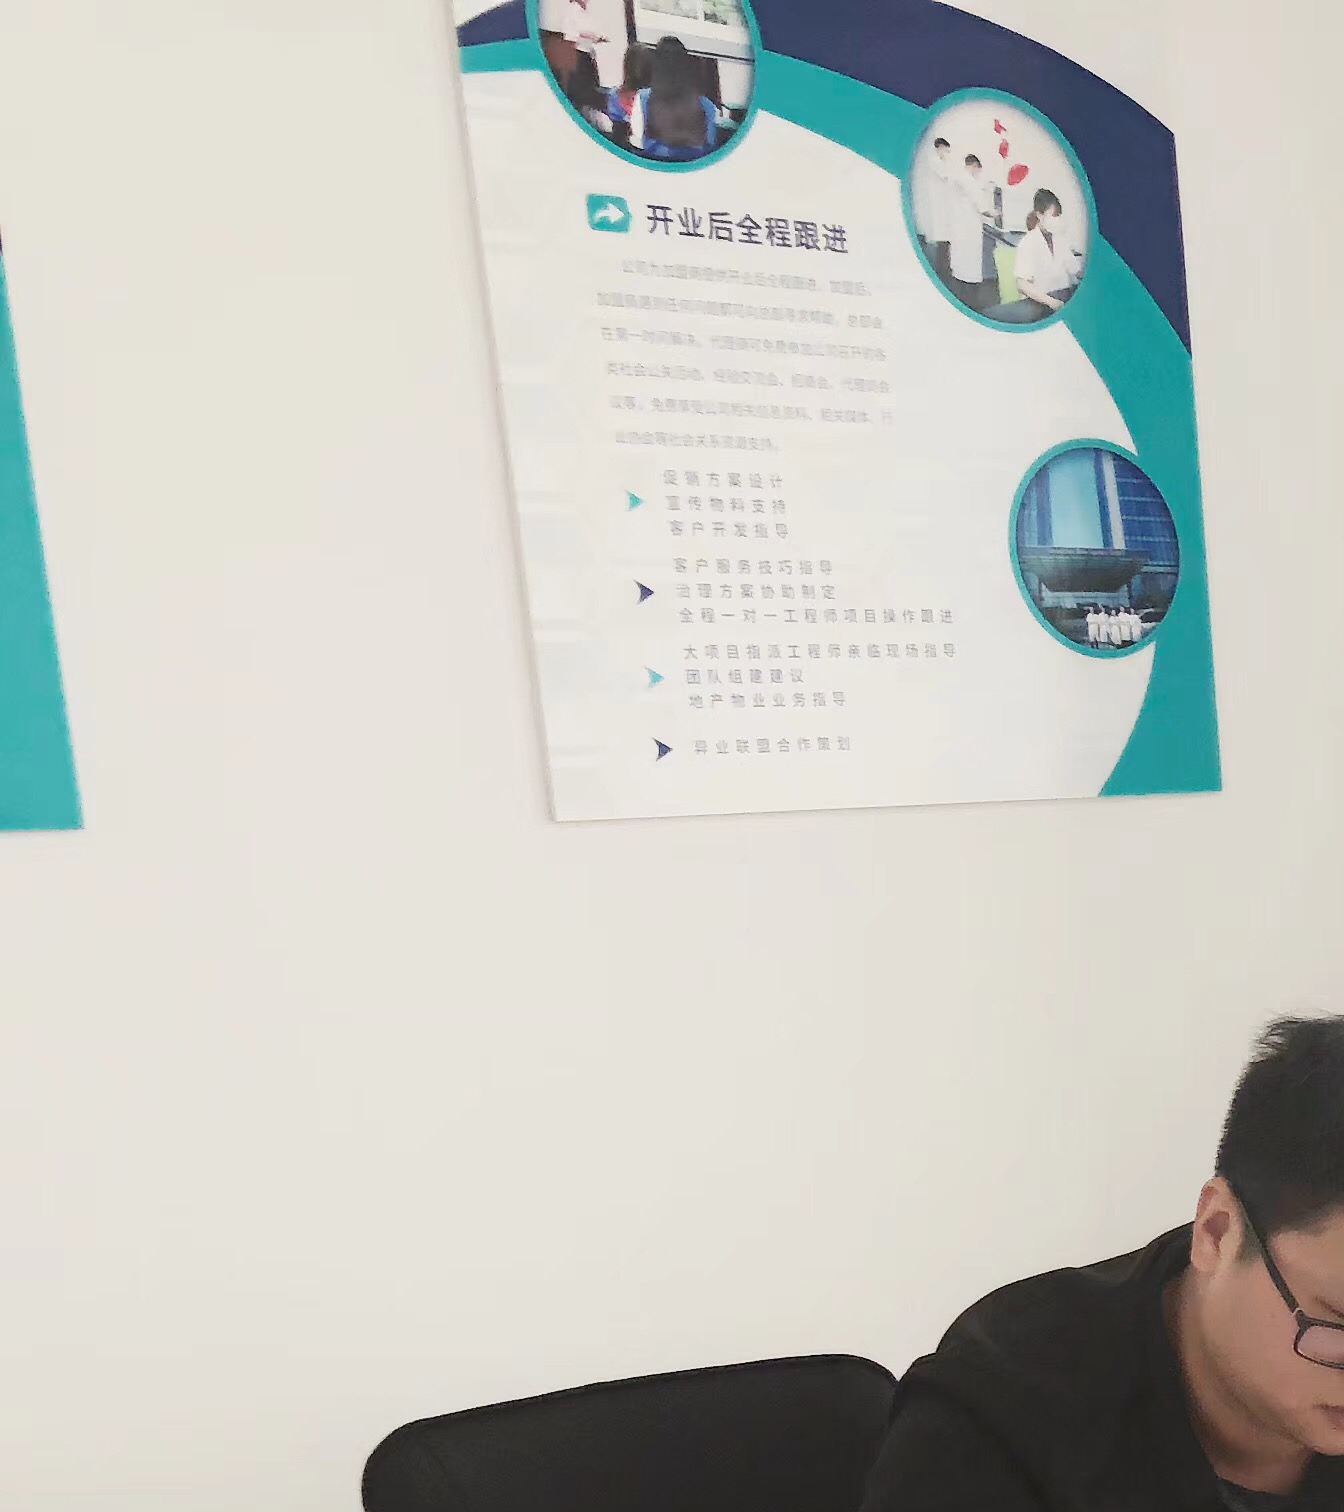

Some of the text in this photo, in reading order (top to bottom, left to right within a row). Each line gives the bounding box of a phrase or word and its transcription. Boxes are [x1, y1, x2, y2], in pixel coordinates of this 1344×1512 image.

[647, 204, 848, 253] 开业后全程跟进
[668, 519, 788, 539] 客户开发指导
[672, 557, 833, 576] 客户服务技巧指导
[679, 608, 954, 624] 全程一对一工程师项目操作跟进
[686, 668, 804, 685] 团队组建建议
[689, 691, 846, 709] 地产物业业务指导
[694, 736, 851, 754] 异业联盟合作策划
